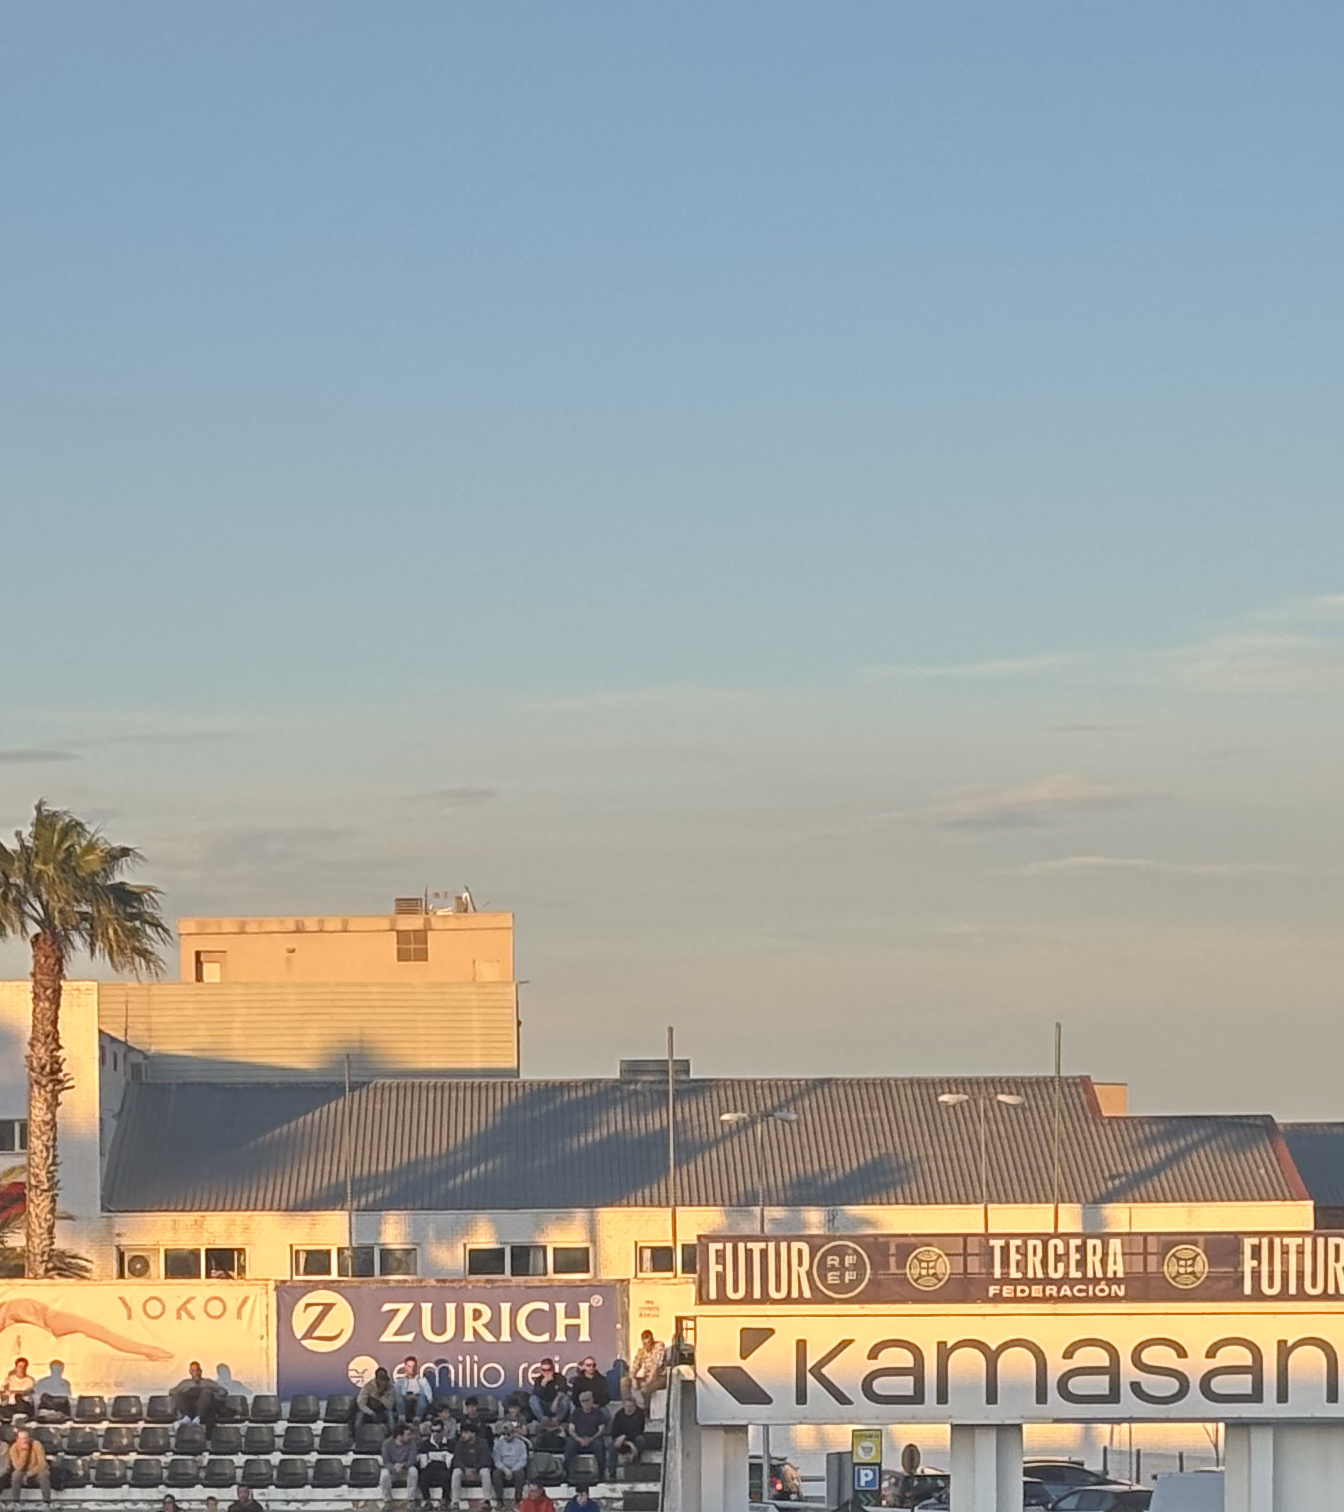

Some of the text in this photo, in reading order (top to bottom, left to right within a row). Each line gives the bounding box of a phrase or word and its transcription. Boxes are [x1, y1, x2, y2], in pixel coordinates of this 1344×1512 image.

[708, 1242, 811, 1300] FUTUR
[989, 1238, 1124, 1279] TERCERA
[988, 1281, 1125, 1298] FEDERACIÓN
[118, 1296, 251, 1321] YOKOY
[378, 1301, 591, 1343] ZURICH
[393, 1354, 505, 1389] emilio
[860, 1468, 873, 1487] P
